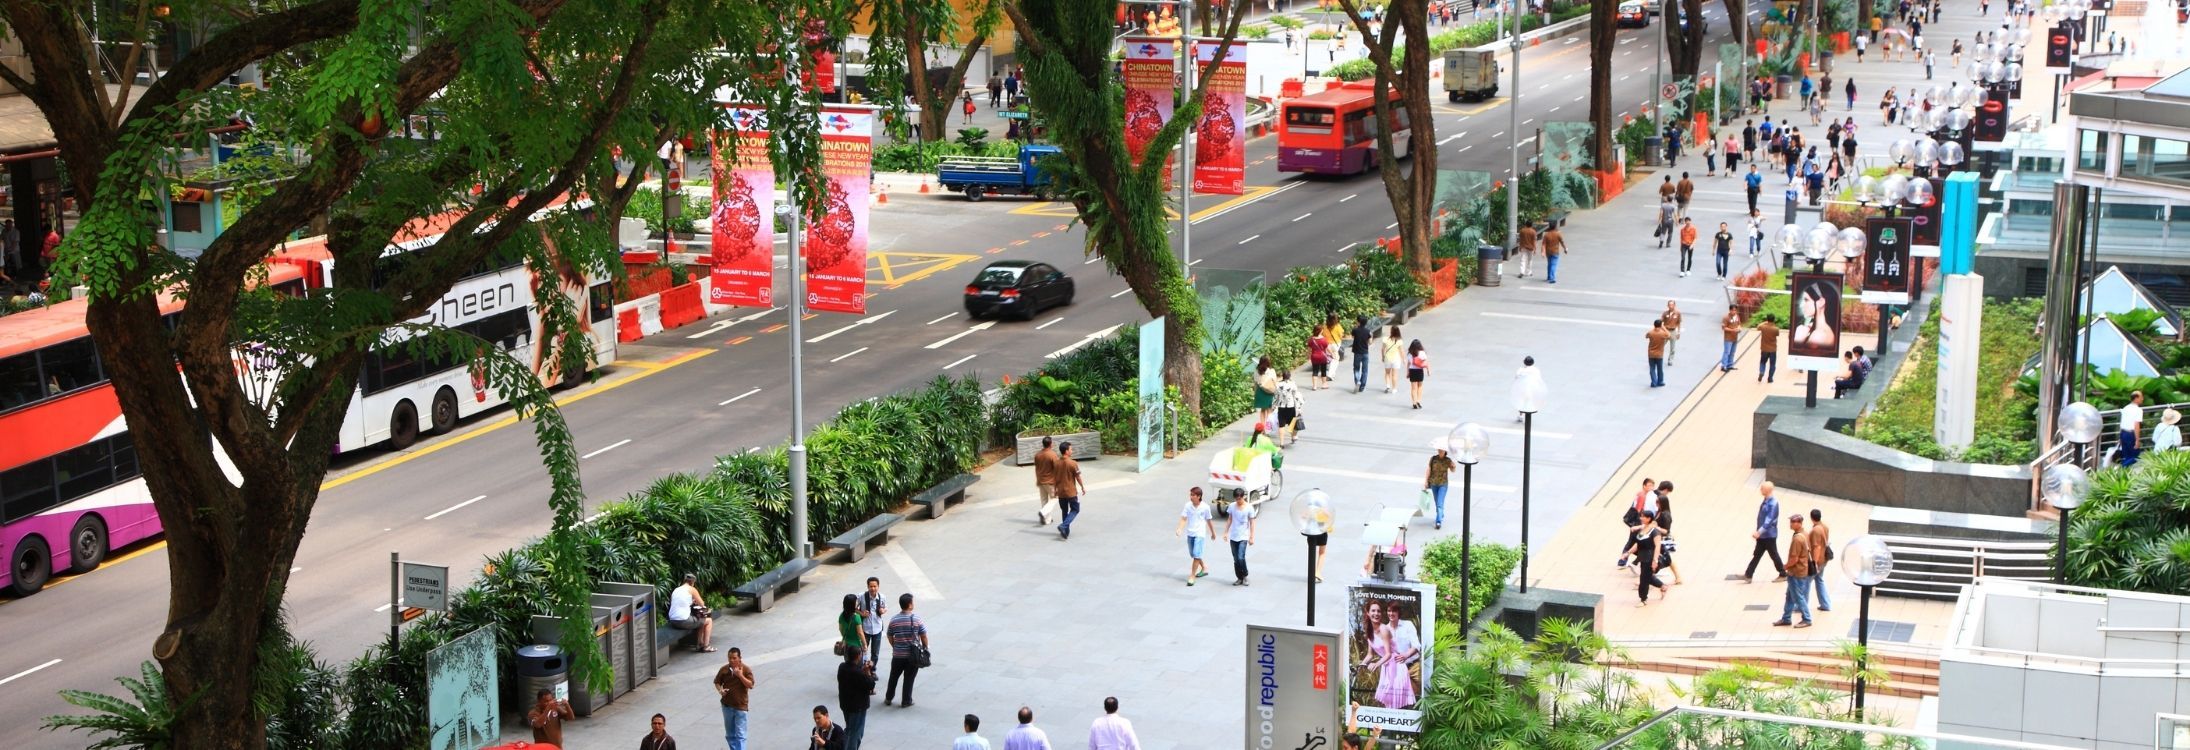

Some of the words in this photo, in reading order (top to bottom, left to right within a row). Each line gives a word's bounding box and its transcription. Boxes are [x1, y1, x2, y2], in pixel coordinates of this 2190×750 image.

[1128, 63, 1172, 71] CHINATOWN
[1200, 65, 1245, 74] CATOWN
[820, 140, 869, 153] INATOWN
[409, 577, 439, 585] PEDESTRIANS
[1387, 594, 1417, 602] MOMENTS
[1315, 649, 1326, 686] 大食代
[1257, 633, 1278, 750] oodrepublic
[1357, 714, 1415, 726] GOLDHEART
